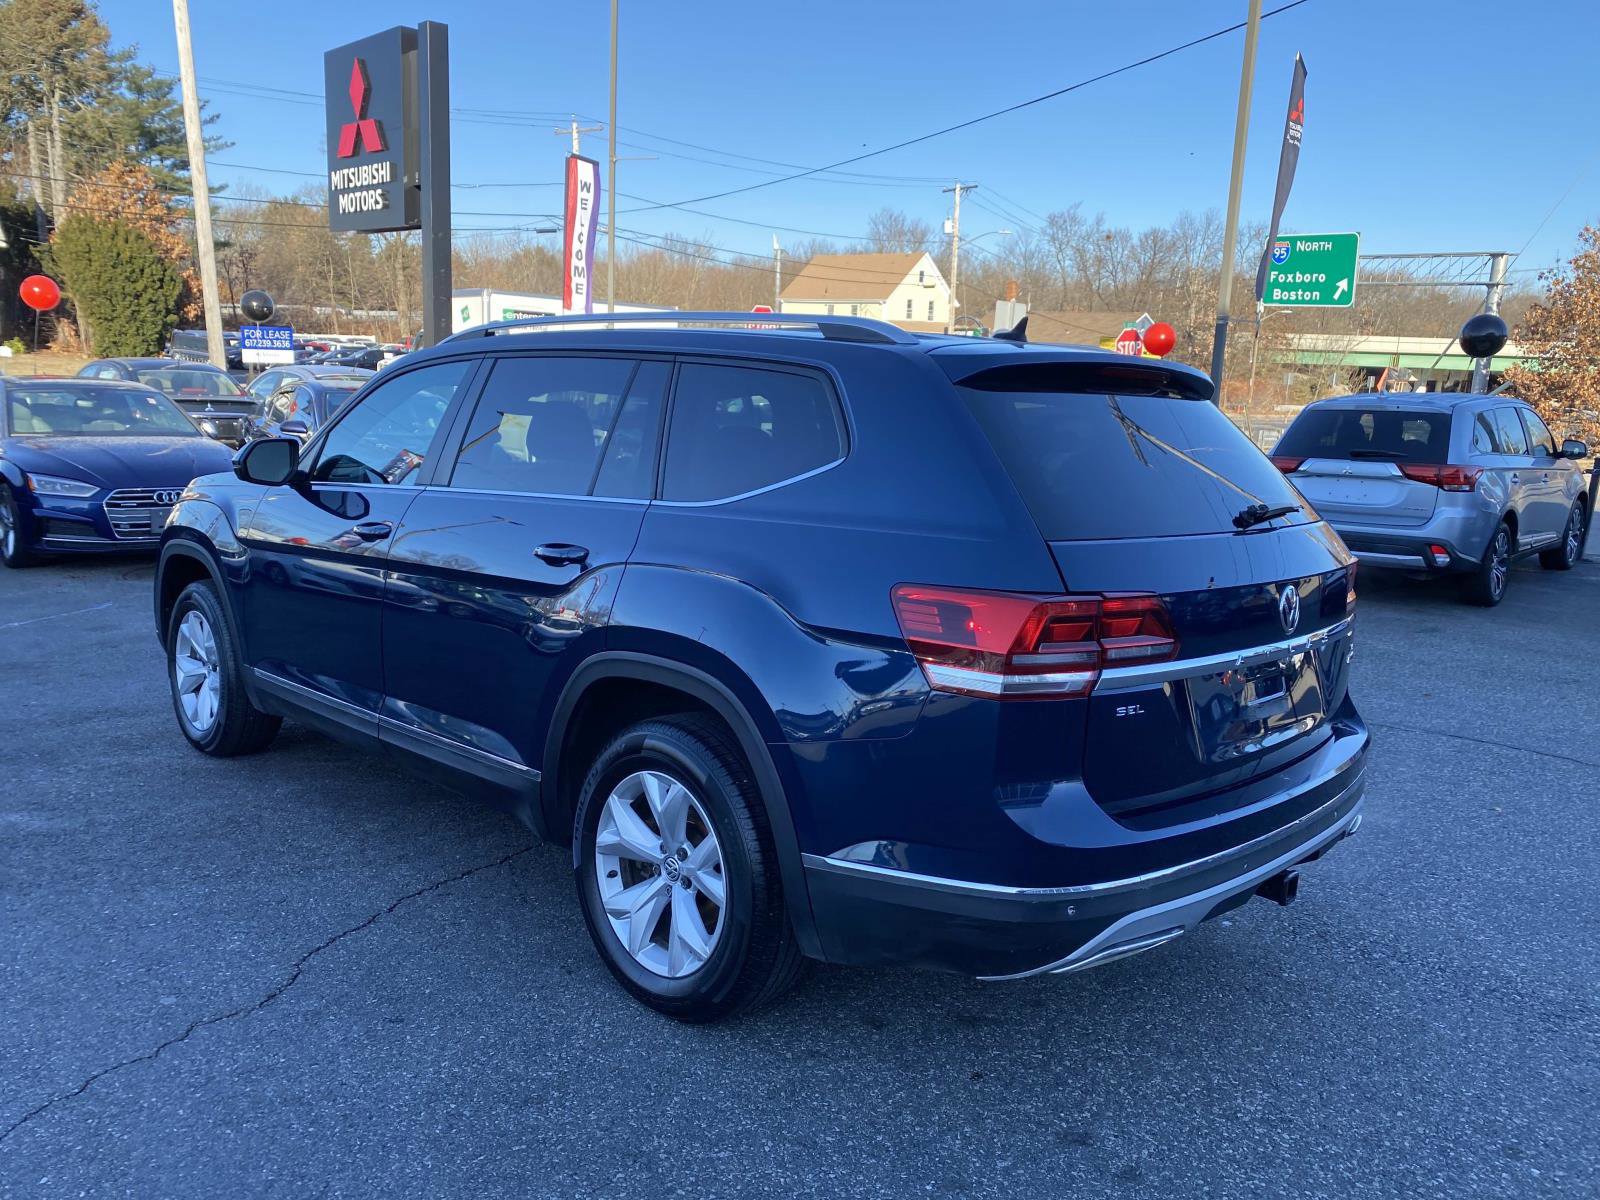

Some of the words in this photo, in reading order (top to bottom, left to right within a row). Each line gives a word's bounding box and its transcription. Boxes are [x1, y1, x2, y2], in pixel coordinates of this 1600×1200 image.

[331, 161, 390, 191] MITSUBISHI
[338, 188, 383, 214] MOTORS
[573, 179, 592, 295] WECOME
[1273, 247, 1287, 259] 95
[1296, 240, 1332, 252] NORTH
[1270, 271, 1326, 283] Foxboro
[1273, 288, 1320, 300] Boston
[244, 329, 262, 339] FOR
[263, 330, 291, 340] LEASE
[1117, 340, 1142, 355] STOP
[1116, 704, 1145, 717] SEL
